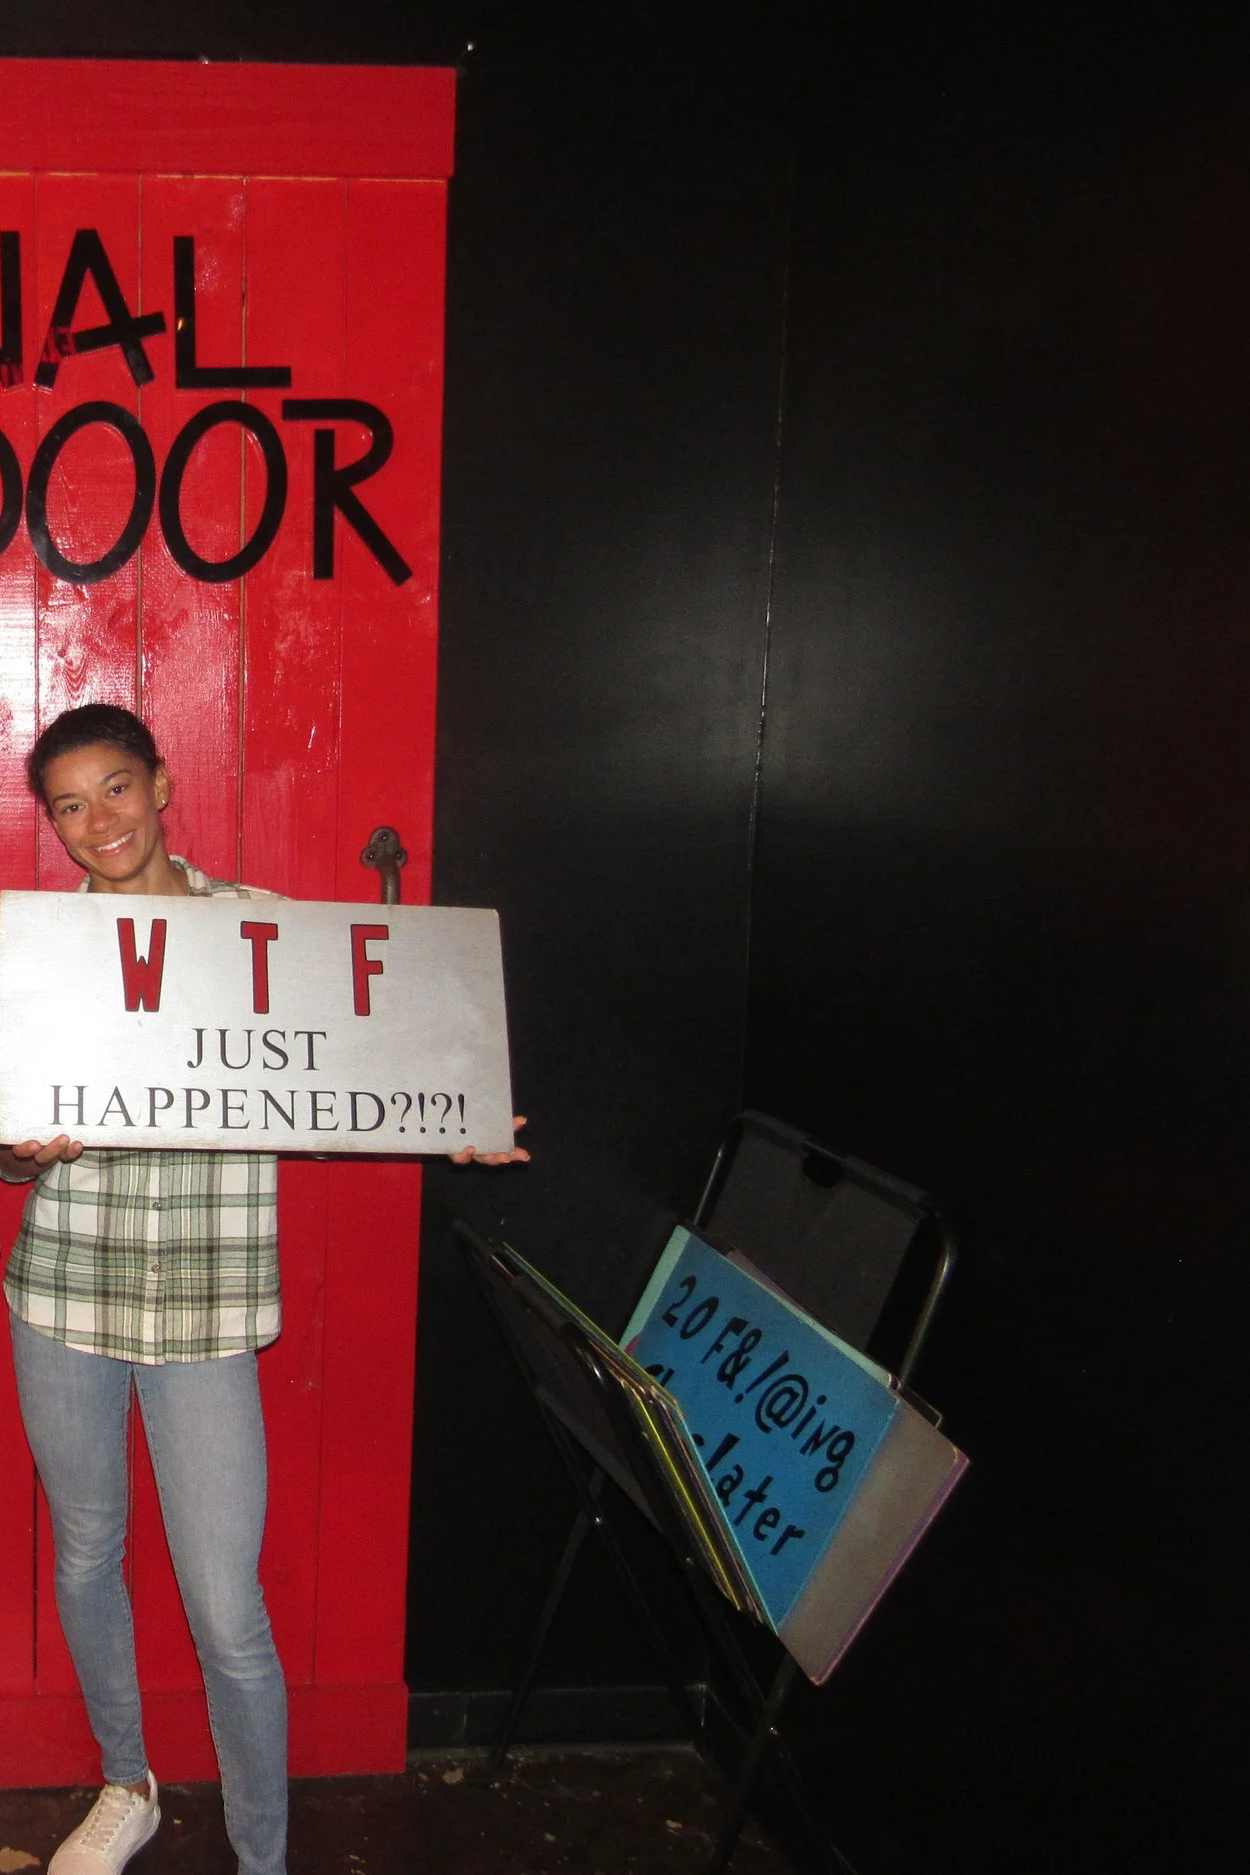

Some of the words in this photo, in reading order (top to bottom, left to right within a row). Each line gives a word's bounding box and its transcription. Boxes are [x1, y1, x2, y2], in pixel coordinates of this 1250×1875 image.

[187, 1028, 328, 1073] JUST
[49, 1085, 468, 1135] HAPPENED?!?!
[661, 1275, 719, 1340] 20
[706, 1432, 805, 1556] later
